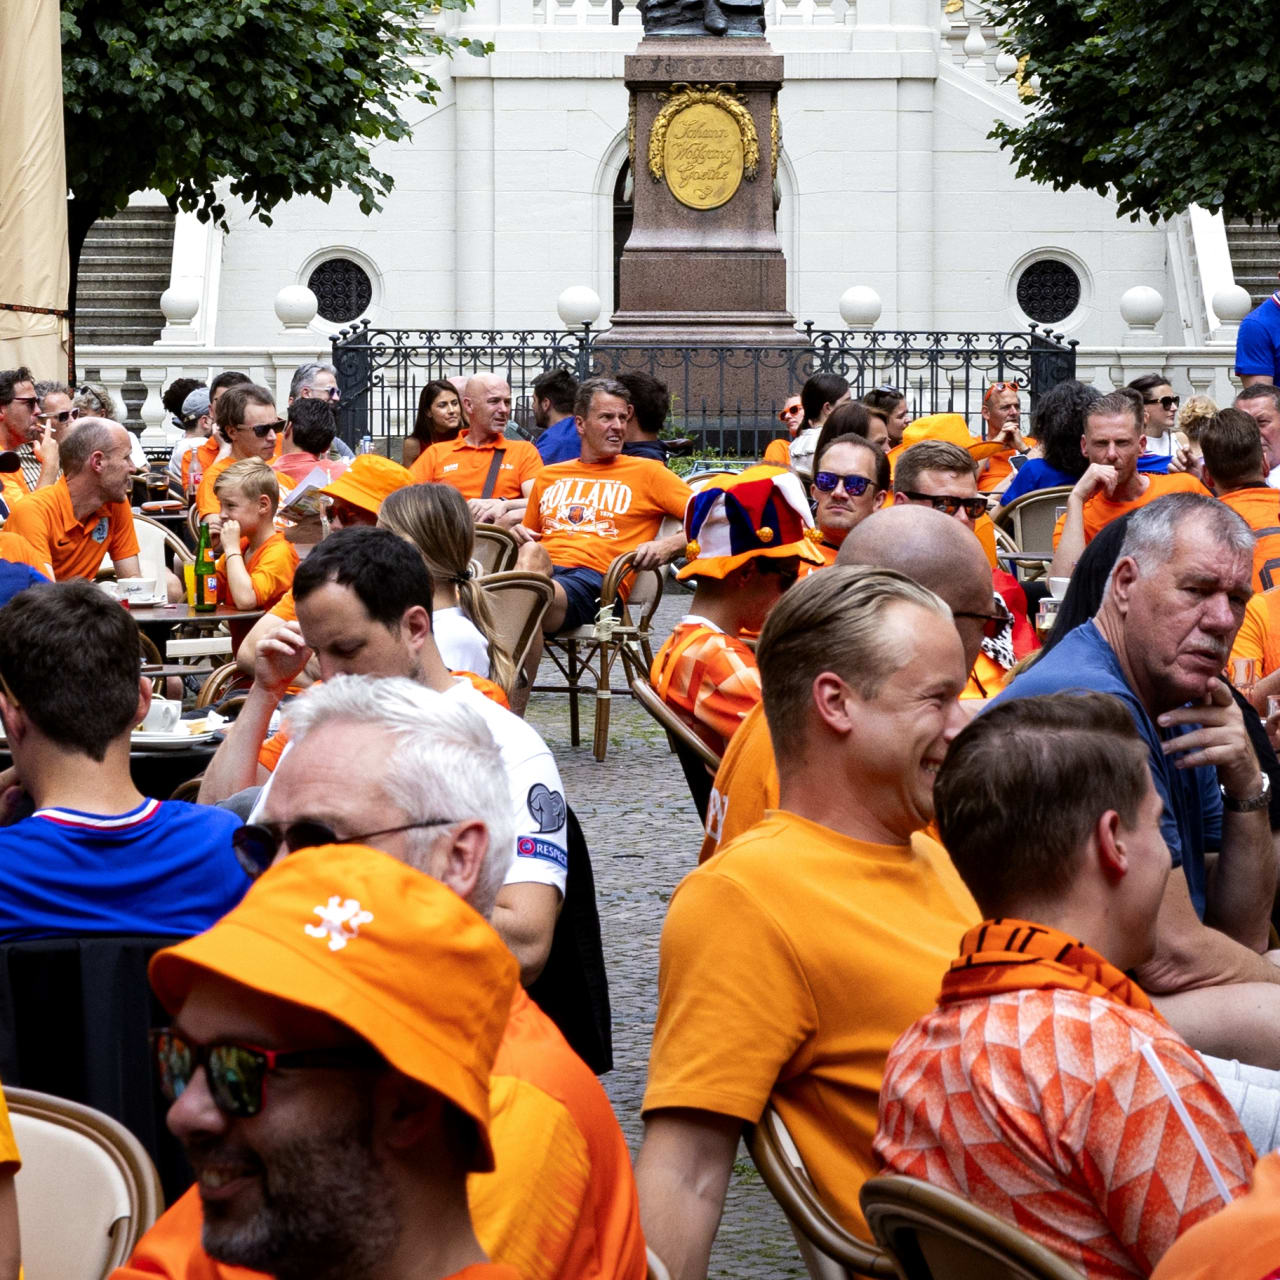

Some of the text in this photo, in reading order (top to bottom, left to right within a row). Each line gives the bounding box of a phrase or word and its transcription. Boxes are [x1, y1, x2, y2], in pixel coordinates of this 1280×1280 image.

[673, 119, 729, 140] Johann
[671, 142, 736, 170] Wolfgang
[677, 164, 730, 189] Goethe
[540, 479, 632, 516] HOLLAND
